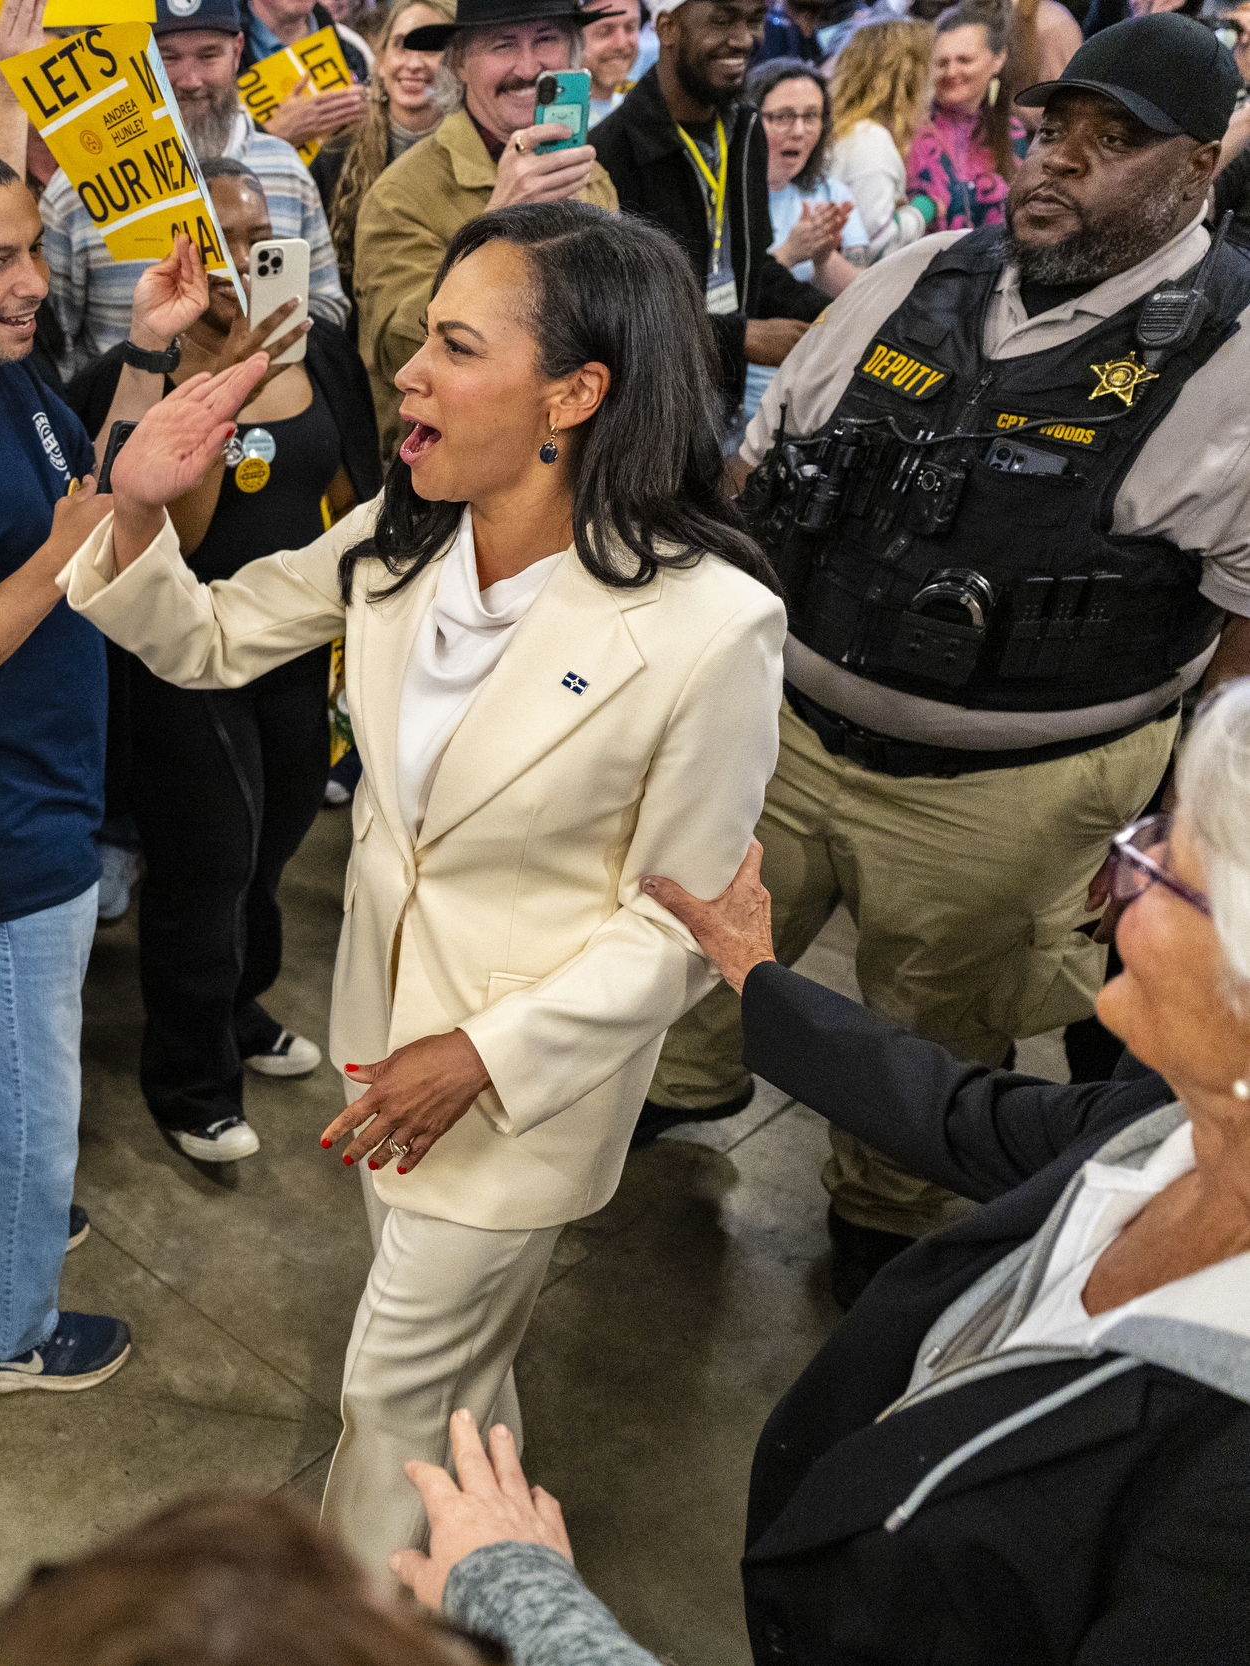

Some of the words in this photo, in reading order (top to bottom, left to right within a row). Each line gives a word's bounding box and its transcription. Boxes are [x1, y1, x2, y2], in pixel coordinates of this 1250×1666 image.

[22, 29, 118, 119] LET'S
[300, 43, 348, 91] LET
[102, 98, 139, 126] ANDREA
[111, 117, 145, 144] HUNLEY
[78, 158, 152, 223] OUR
[144, 136, 196, 196] NEX
[863, 344, 945, 396] DEPUTY
[996, 413, 1028, 429] CPT
